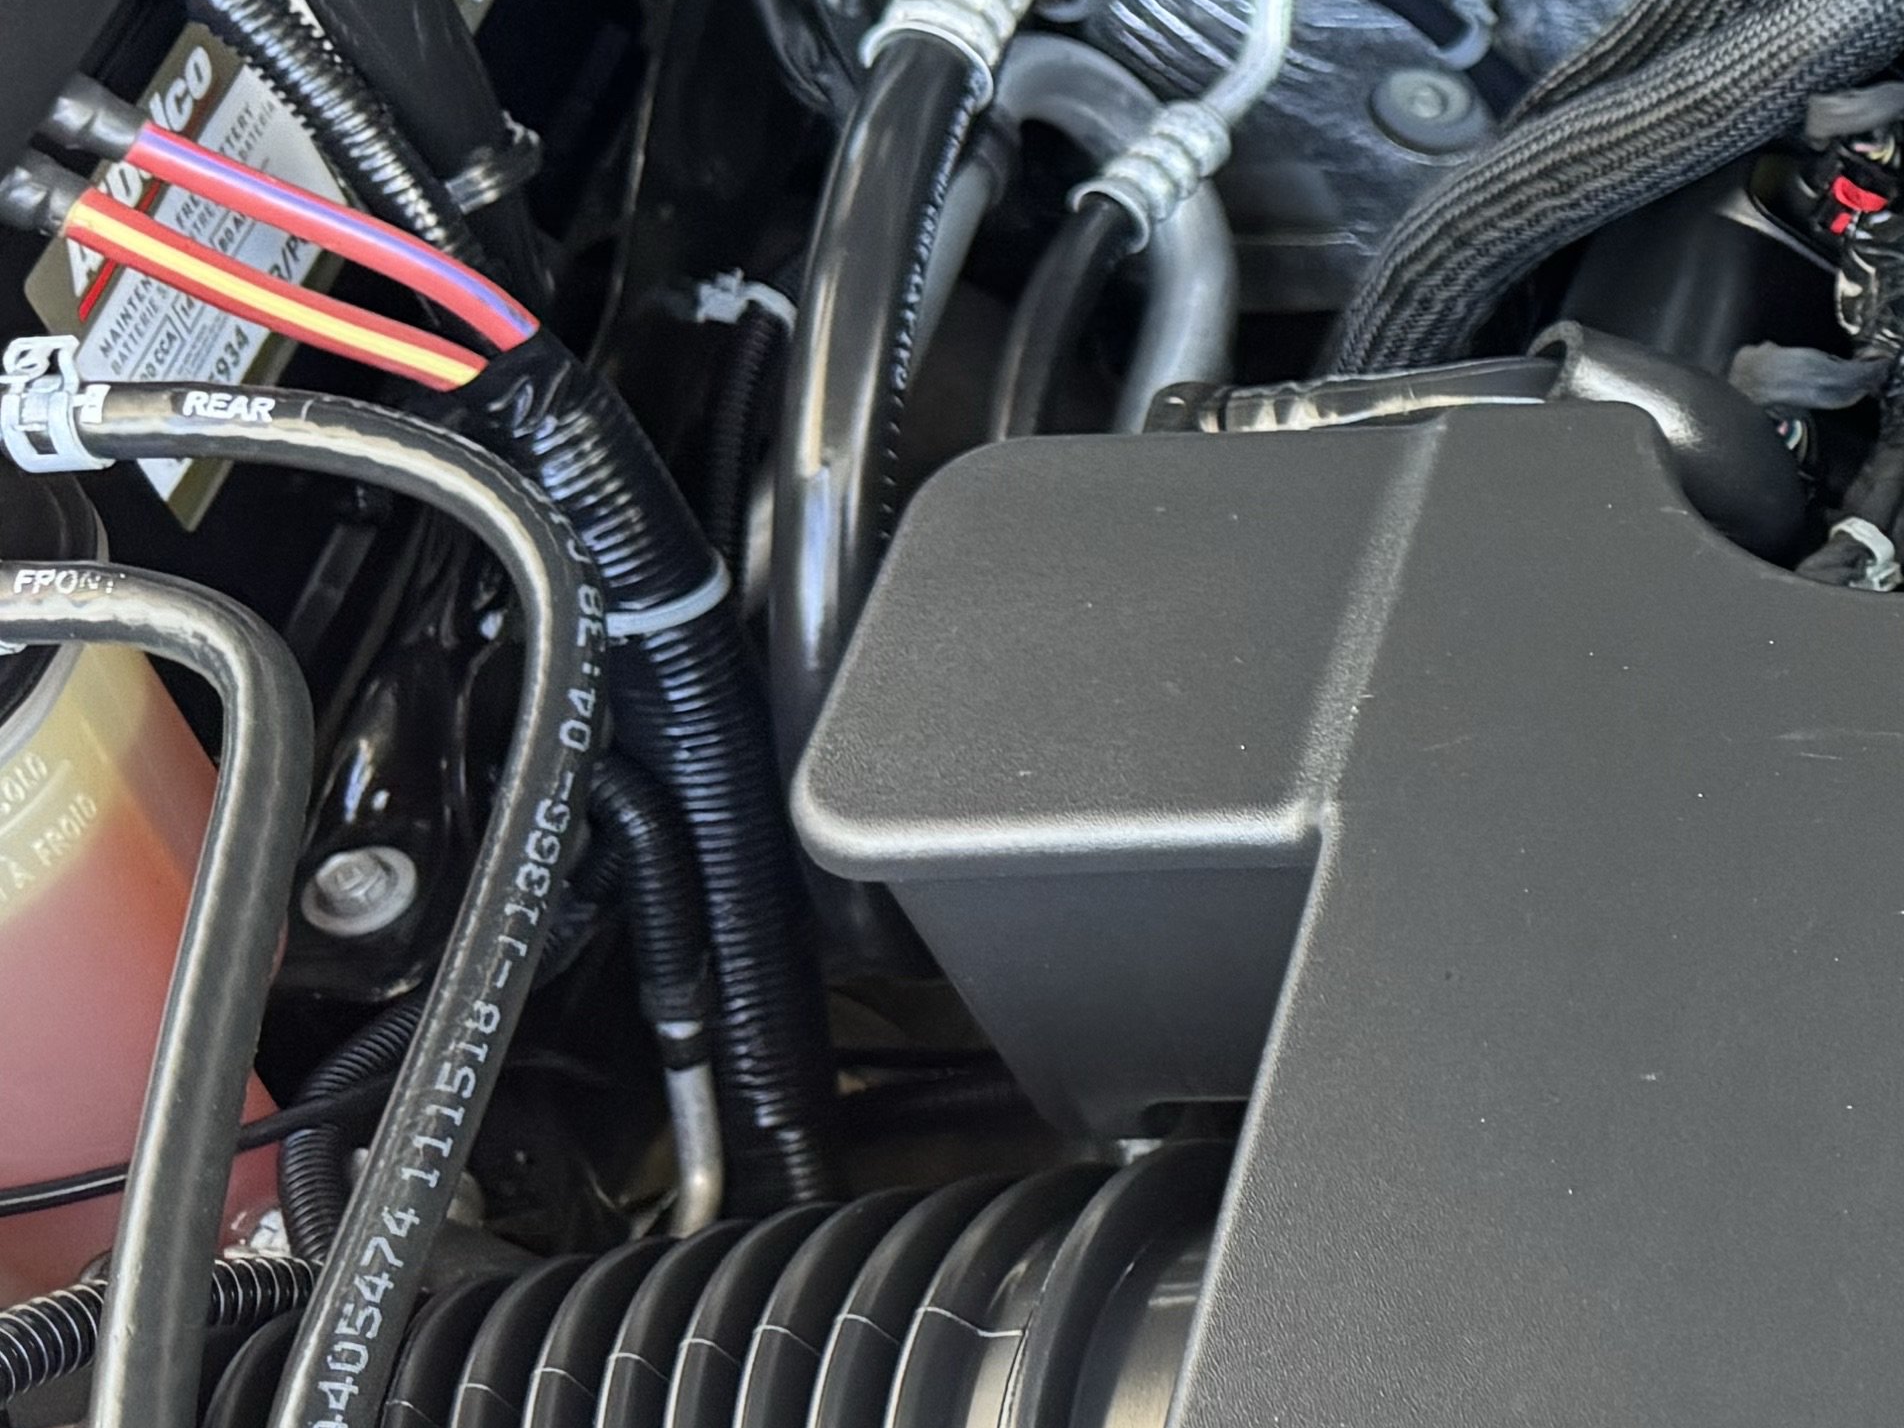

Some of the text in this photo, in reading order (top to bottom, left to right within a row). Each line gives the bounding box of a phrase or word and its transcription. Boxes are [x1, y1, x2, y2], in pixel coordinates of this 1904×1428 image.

[68, 43, 213, 299] ADlco
[98, 277, 154, 355] MAINTEN
[172, 192, 202, 230] FRE
[150, 330, 178, 365] CCA
[182, 389, 276, 425] REAR
[402, 1001, 500, 1186] 111518
[557, 583, 609, 752] 04:38
